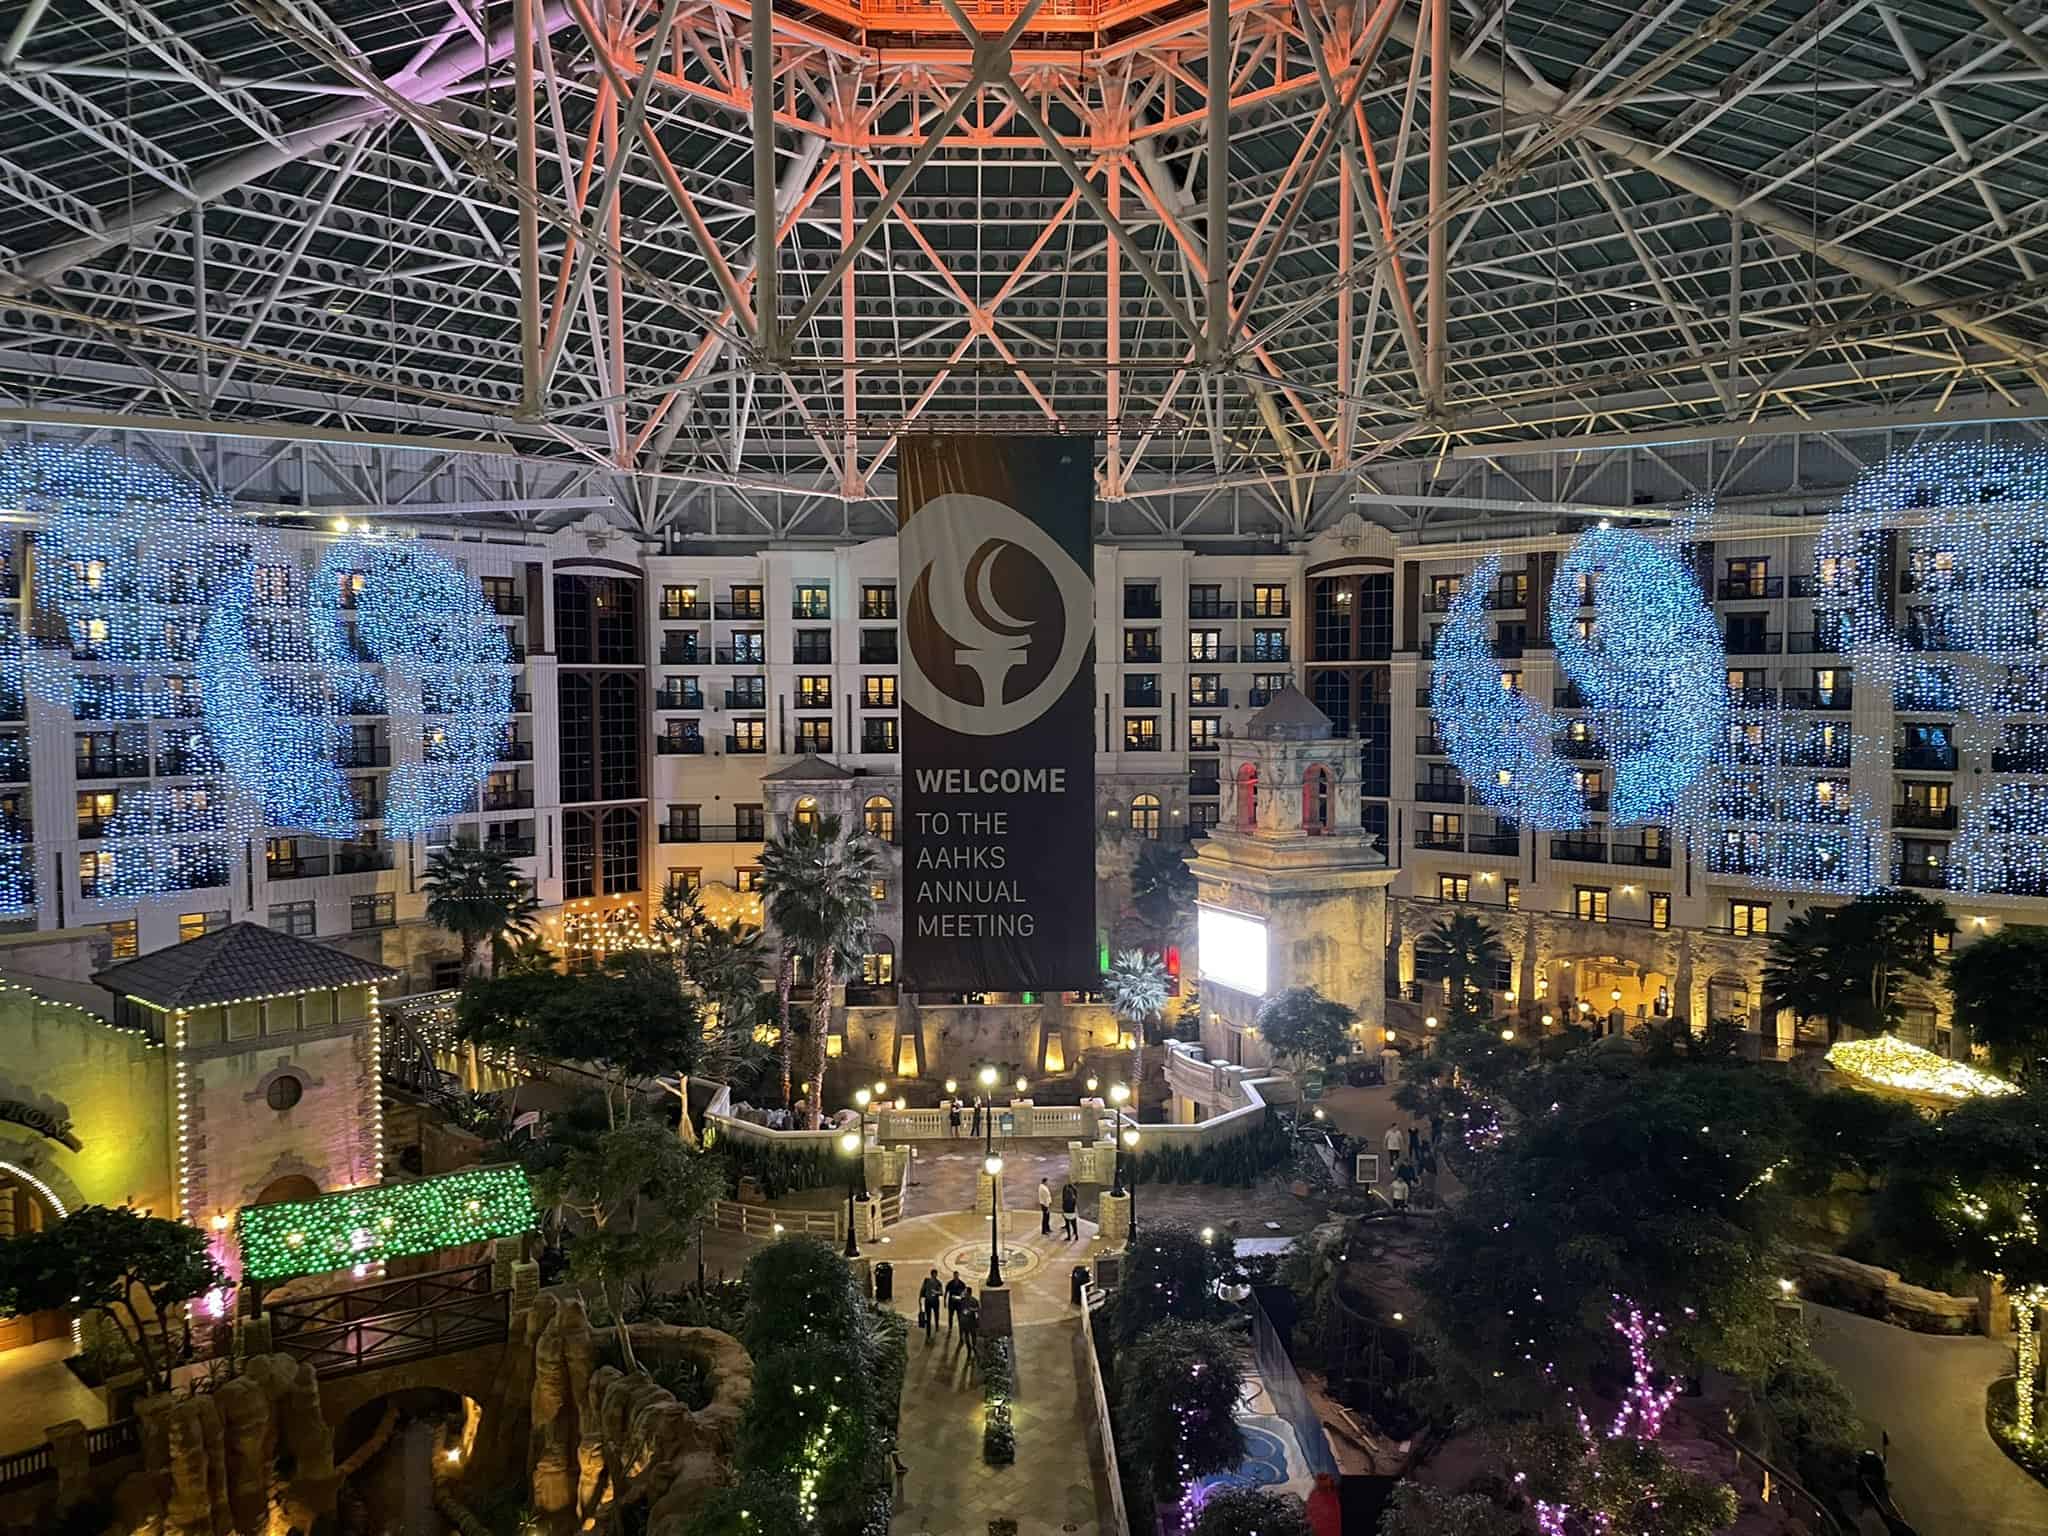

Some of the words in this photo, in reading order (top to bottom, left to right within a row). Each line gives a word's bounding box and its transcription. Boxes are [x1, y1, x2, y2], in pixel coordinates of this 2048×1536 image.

[915, 768, 1066, 793] WELCOME
[915, 812, 949, 834] TO
[957, 812, 1008, 834] THE
[916, 846, 1005, 869] AAHKS
[916, 880, 1026, 903] ANNUAL
[918, 914, 1034, 937] MEETING
